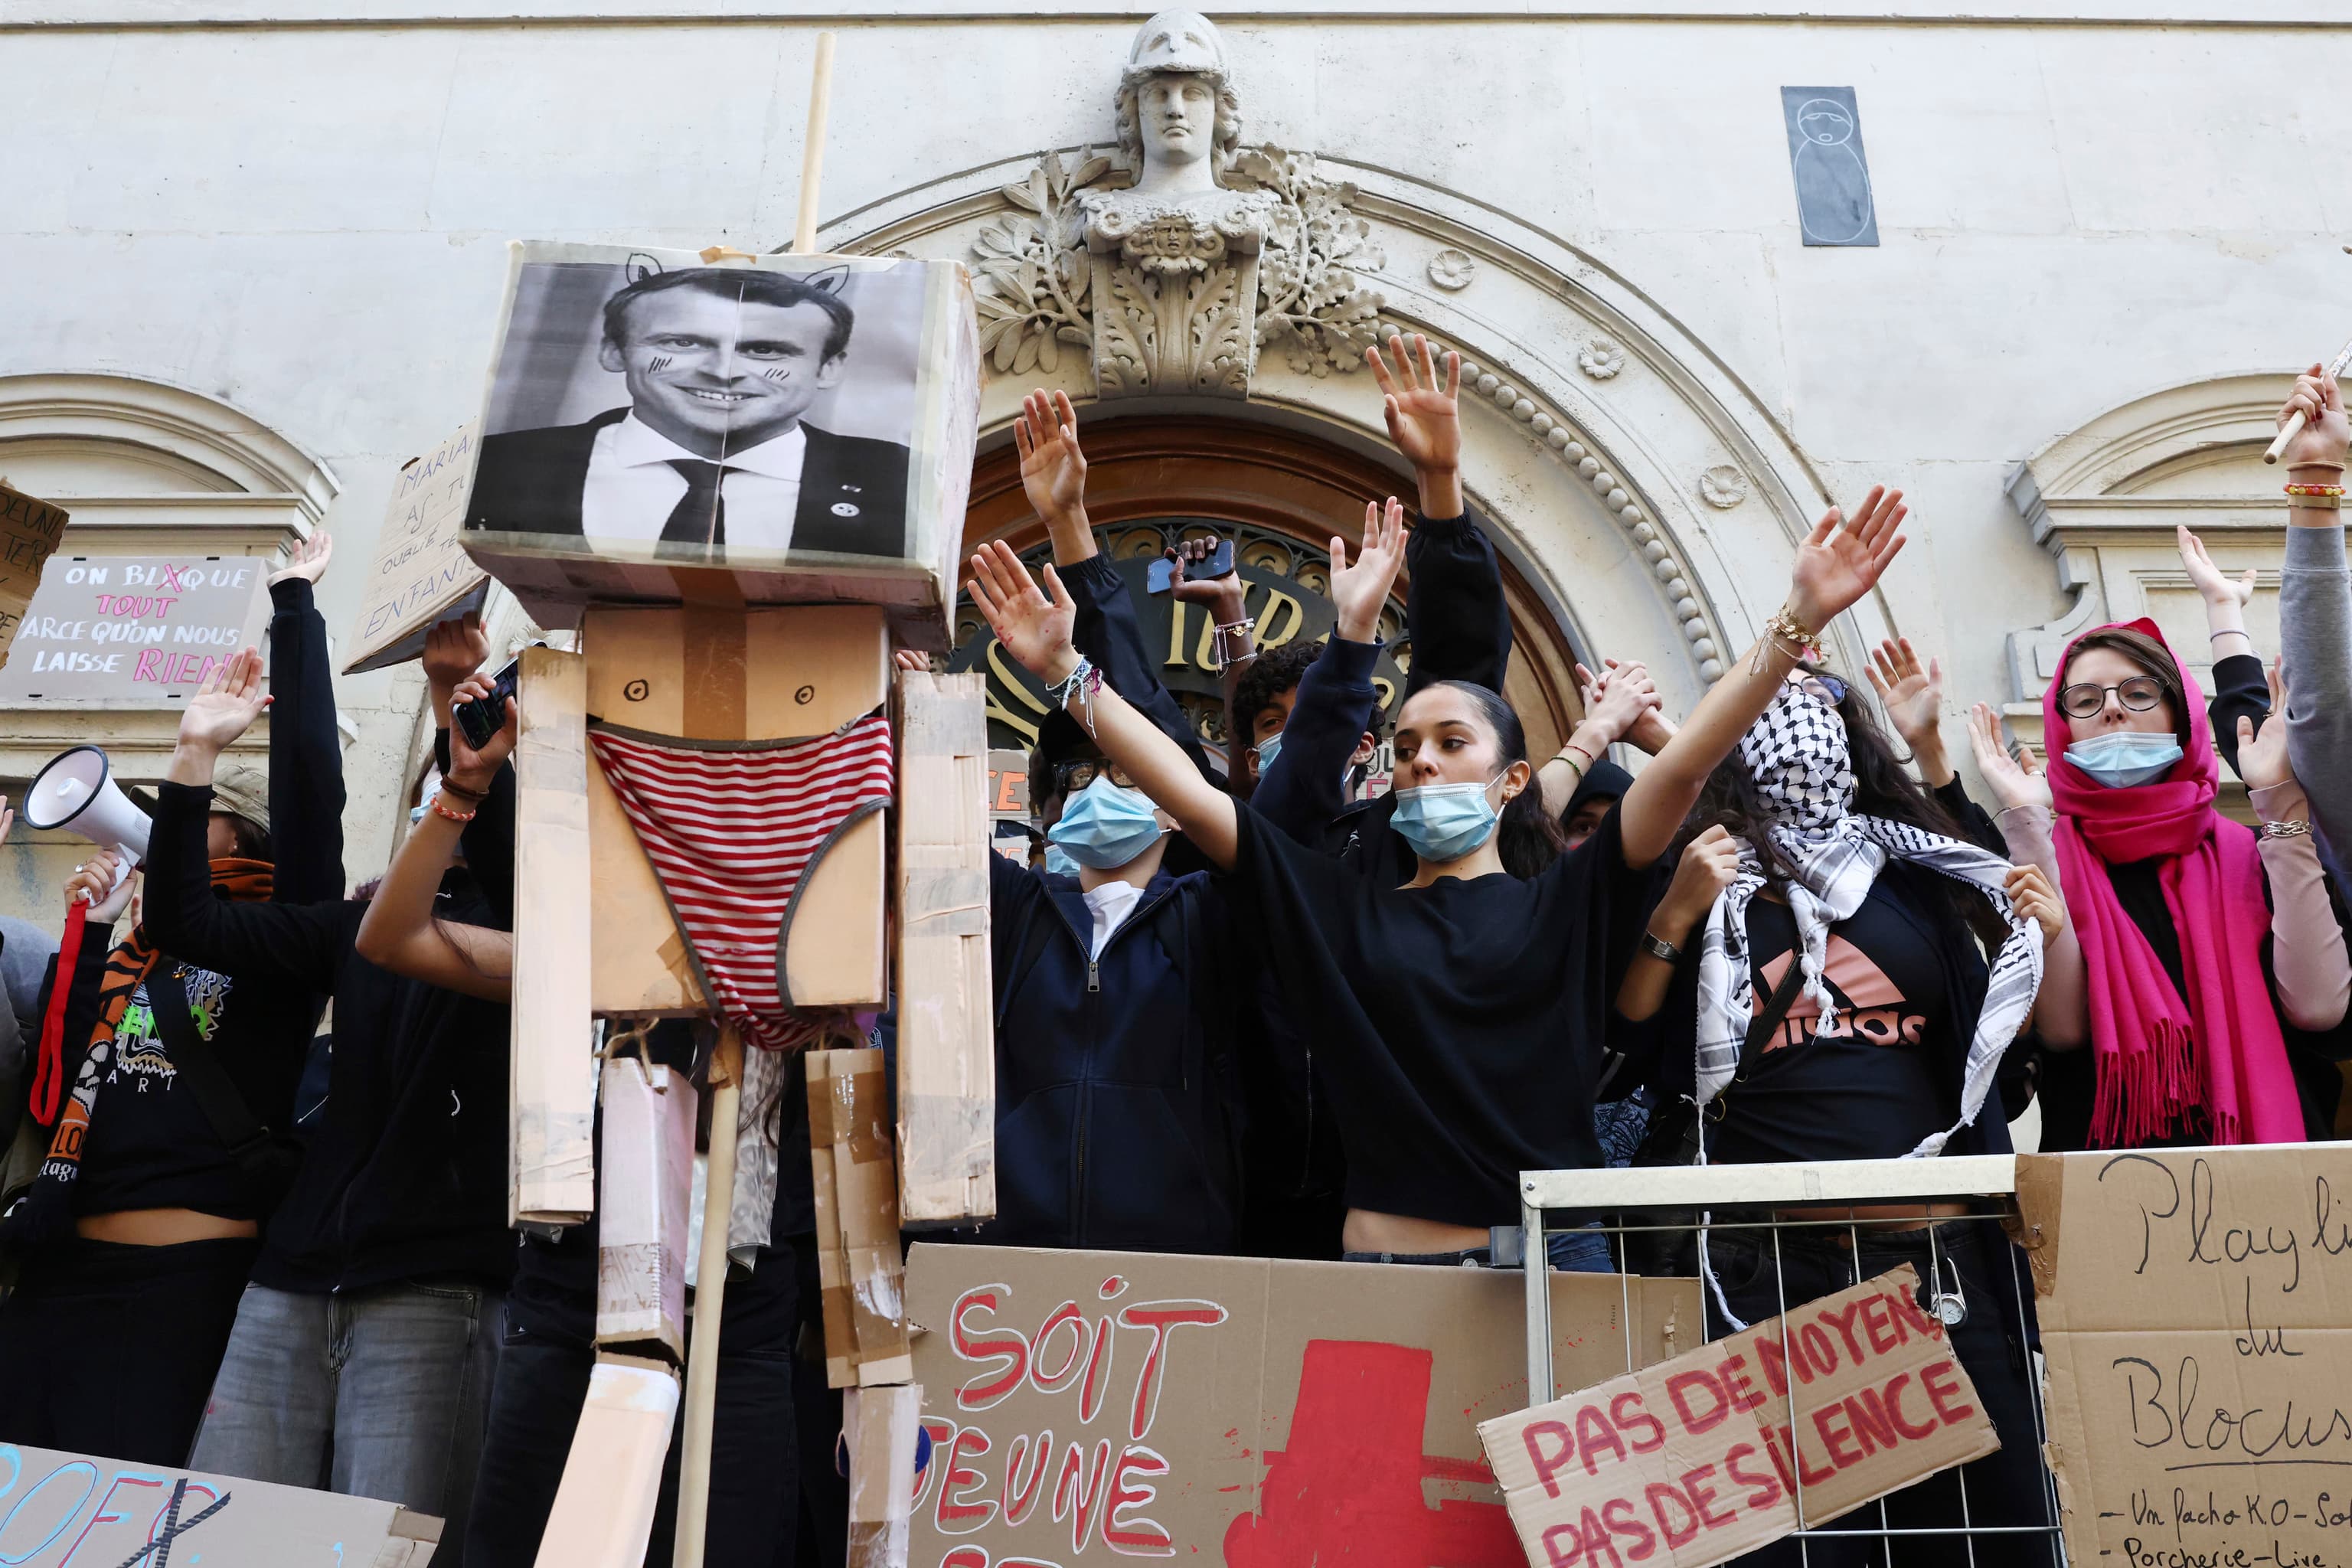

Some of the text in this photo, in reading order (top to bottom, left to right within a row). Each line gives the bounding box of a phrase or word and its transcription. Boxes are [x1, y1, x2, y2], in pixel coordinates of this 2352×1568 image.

[403, 493, 433, 534] AS
[65, 567, 108, 586] ON
[96, 594, 178, 618] TOUT
[364, 552, 469, 639] ENFANT
[19, 616, 90, 642] ARCE
[173, 624, 240, 645] NOUS
[31, 648, 234, 684] LAISSE RIEN
[106, 1069, 174, 1094] ARI
[2098, 1154, 2352, 1293] Playli
[2236, 1276, 2304, 1356] du
[1521, 1390, 1668, 1499] PAS
[1664, 1353, 1768, 1436] DE
[2112, 1356, 2352, 1457] Blocus
[1540, 1498, 1657, 1568] PAS
[1644, 1462, 1739, 1551] DE
